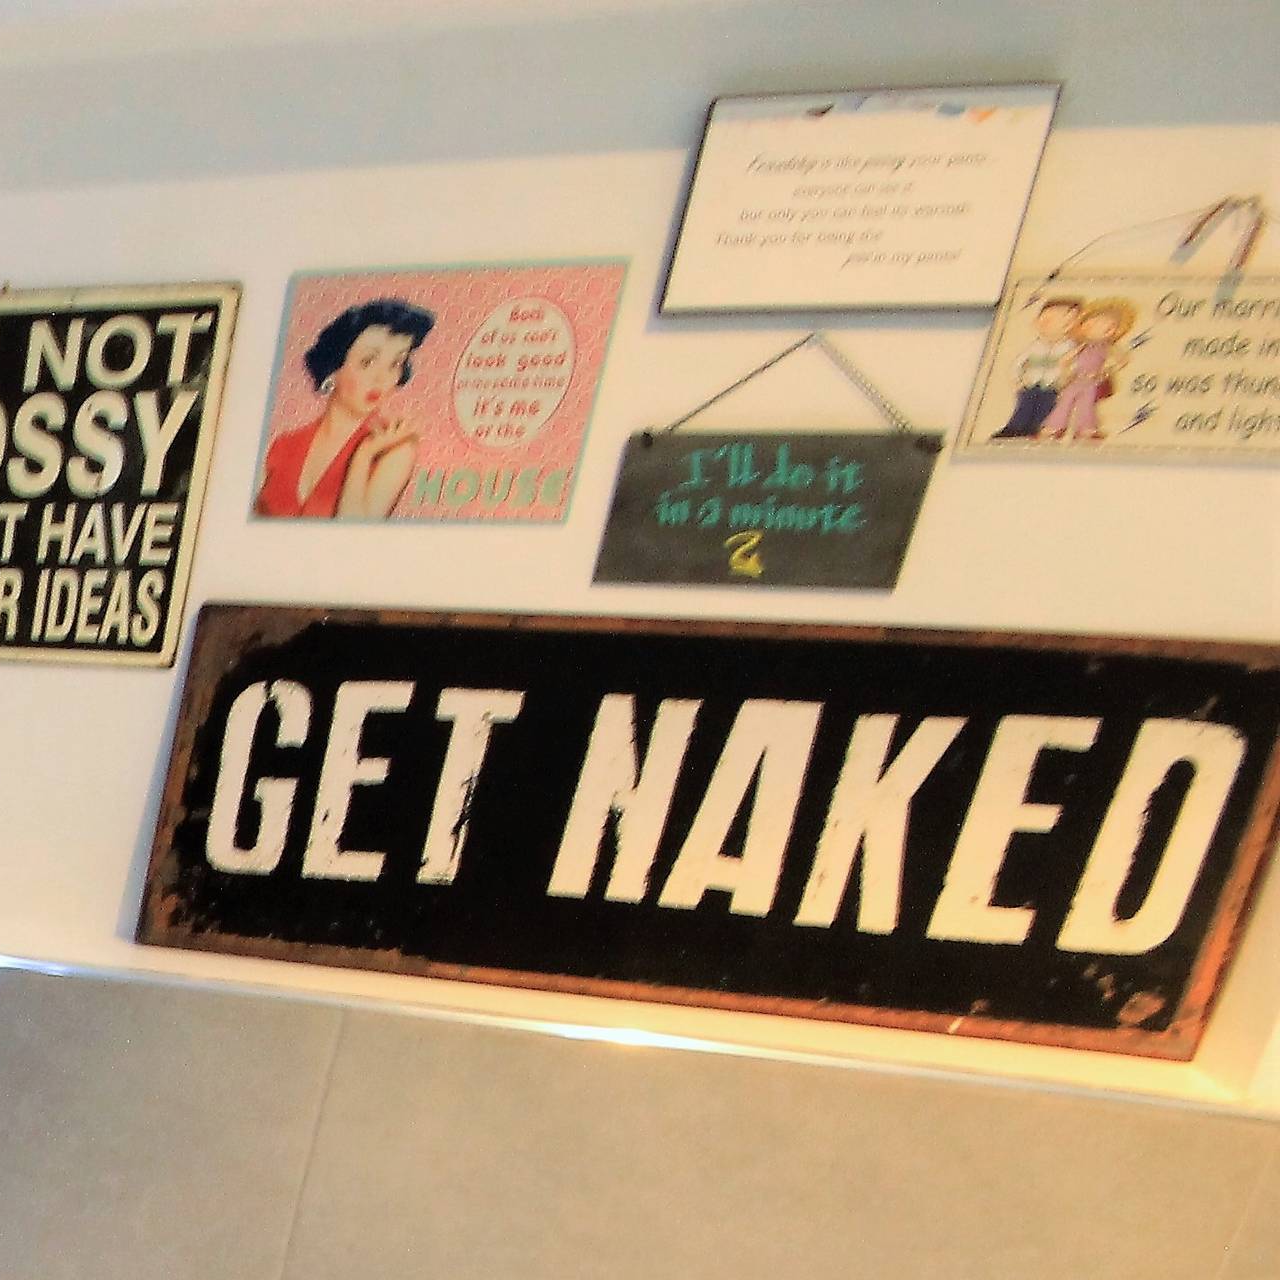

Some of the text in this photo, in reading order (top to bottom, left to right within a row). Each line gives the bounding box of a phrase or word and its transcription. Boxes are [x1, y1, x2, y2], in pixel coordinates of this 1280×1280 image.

[1157, 291, 1205, 317] Our
[23, 312, 214, 393] NOT
[1183, 330, 1252, 356] made
[465, 354, 566, 372] look good
[1131, 374, 1157, 394] so
[1166, 374, 1214, 394] was
[510, 399, 540, 416] me
[1176, 406, 1223, 431] and
[413, 468, 569, 507] HOUSE
[728, 495, 865, 532] minute
[36, 501, 178, 566] HAVE
[30, 568, 165, 647] IDEAS
[206, 679, 1246, 957] GET NAKED
